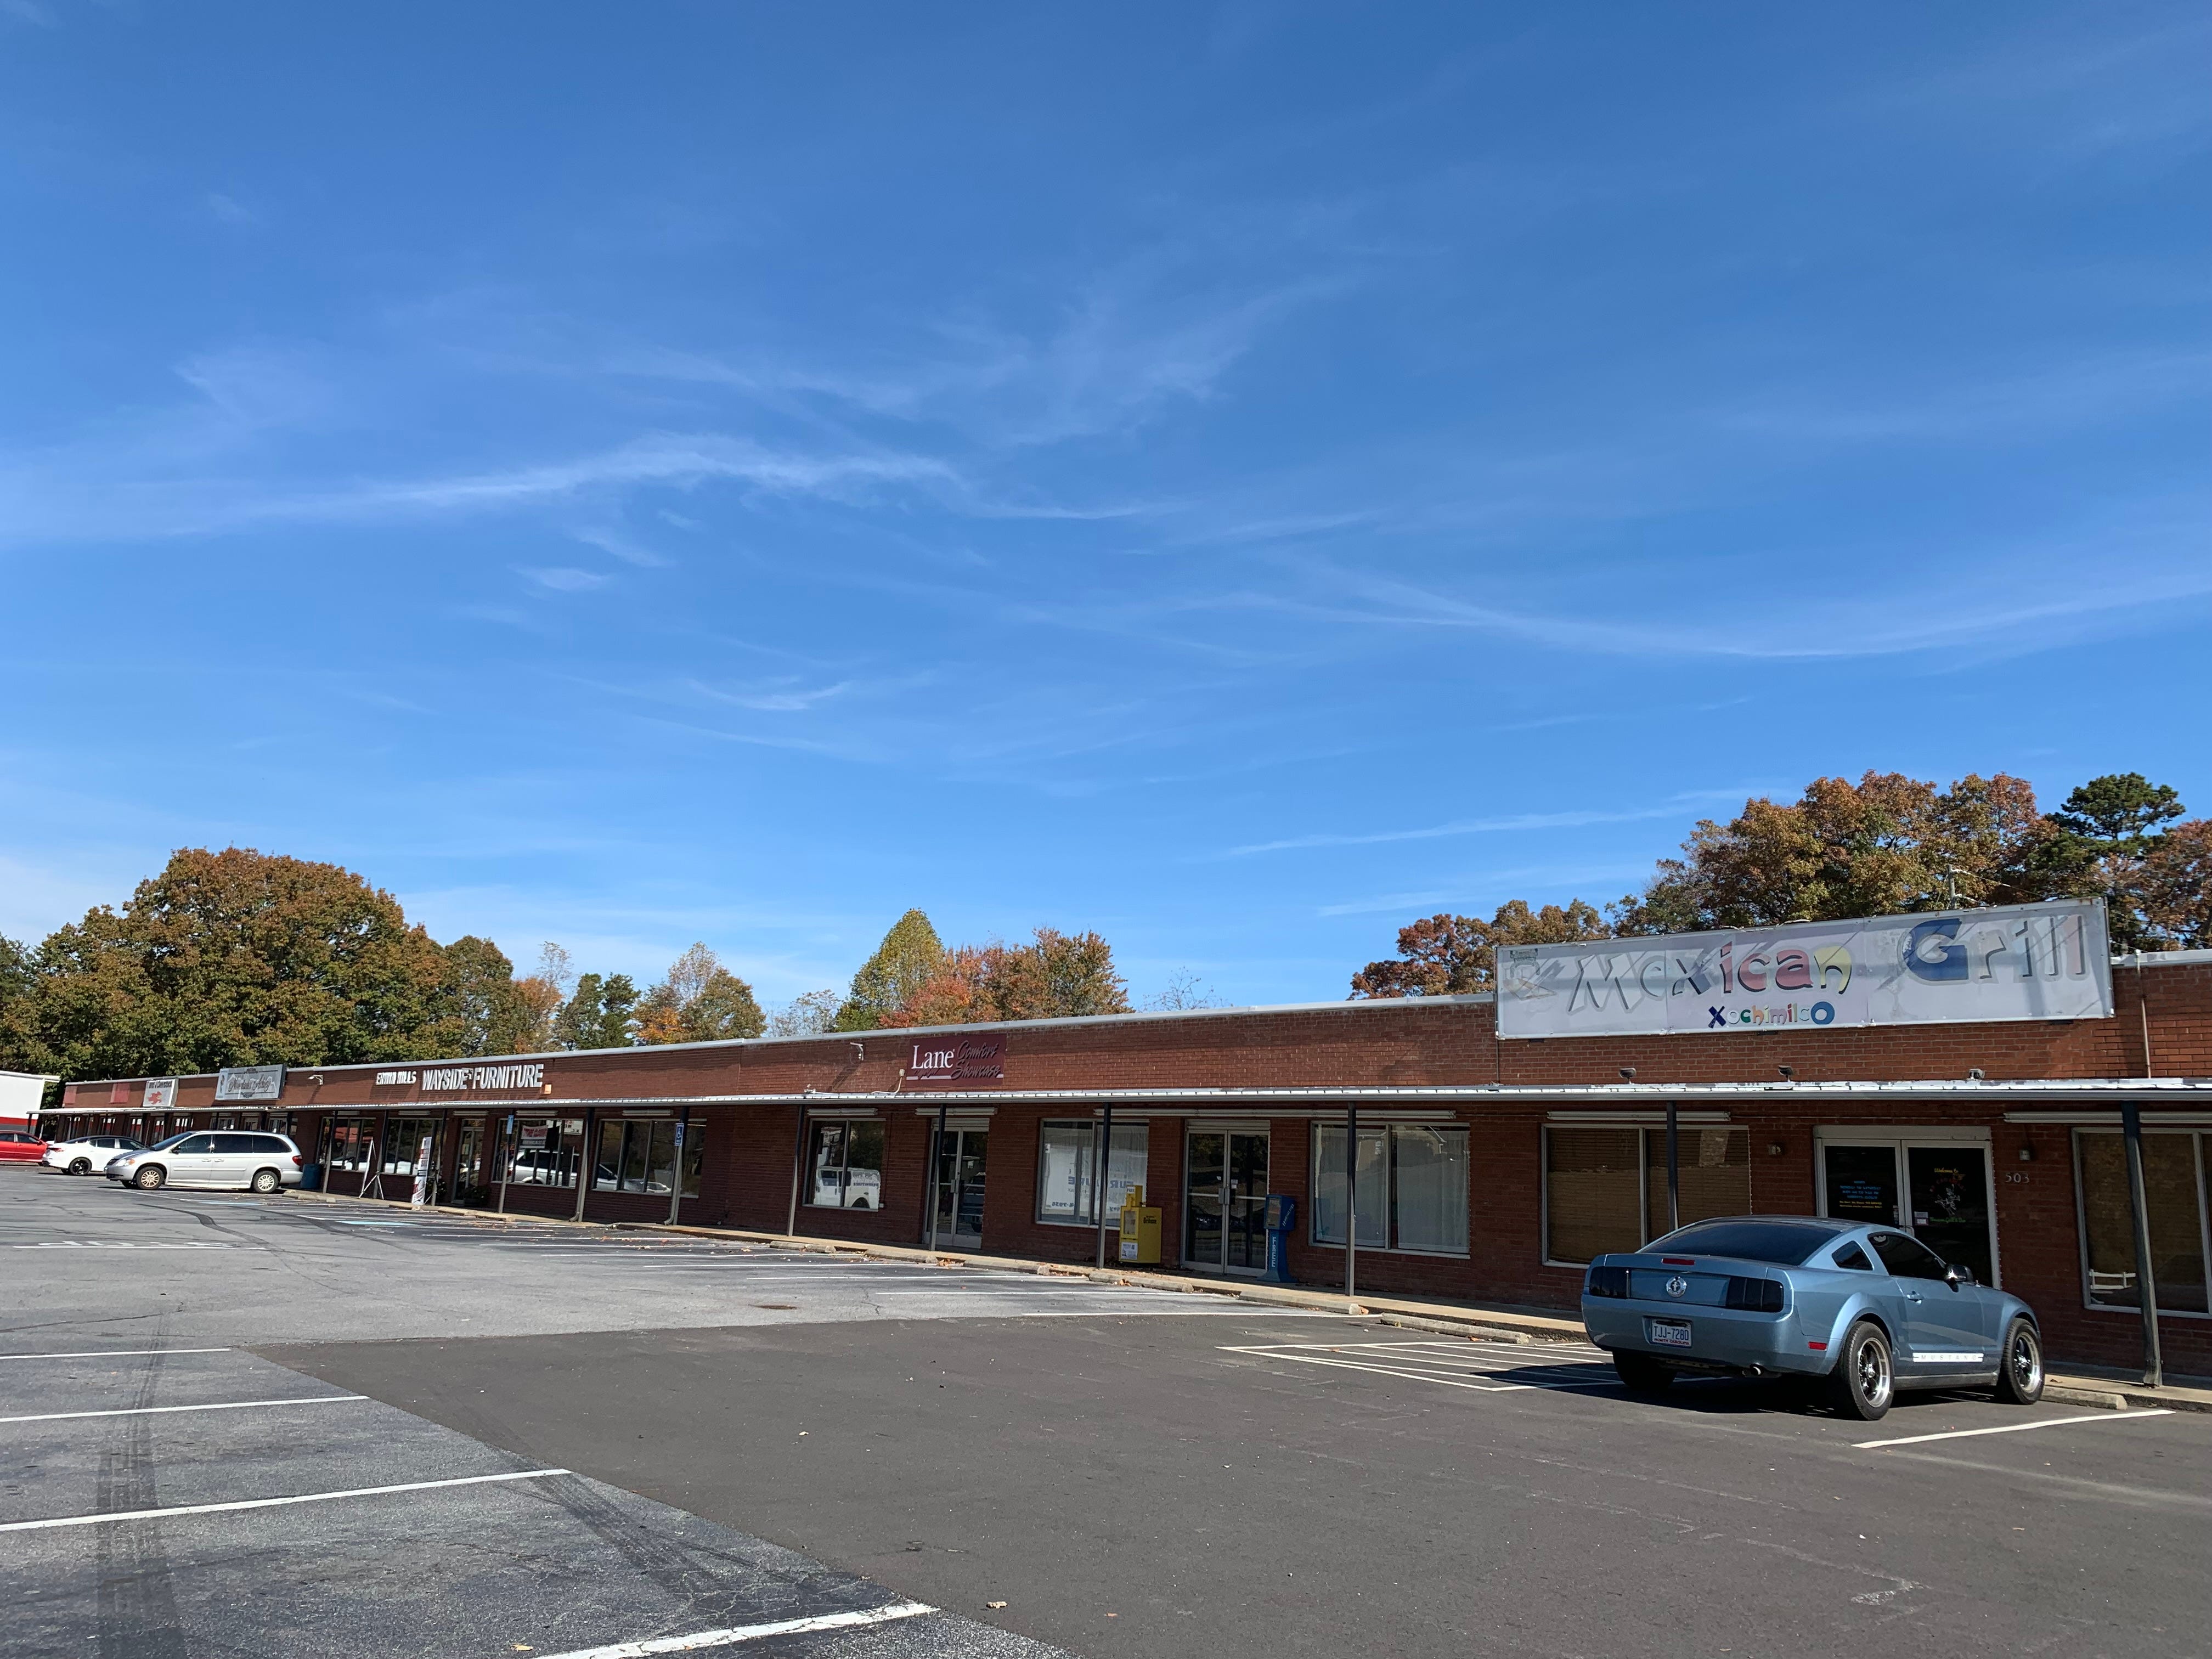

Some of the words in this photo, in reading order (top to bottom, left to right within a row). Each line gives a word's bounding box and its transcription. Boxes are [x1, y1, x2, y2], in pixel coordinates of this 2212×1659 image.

[1567, 940, 1852, 1013] Mexican
[1901, 915, 2085, 981] Grill
[911, 1045, 955, 1069] Lane
[957, 1040, 999, 1060] Comfort
[422, 1069, 467, 1091] WAYSIDE
[472, 1064, 544, 1090] FURNITURE
[951, 1059, 1001, 1080] Showcase
[2005, 1172, 2029, 1183] 503
[1654, 1325, 1689, 1341] TJJ-7280
